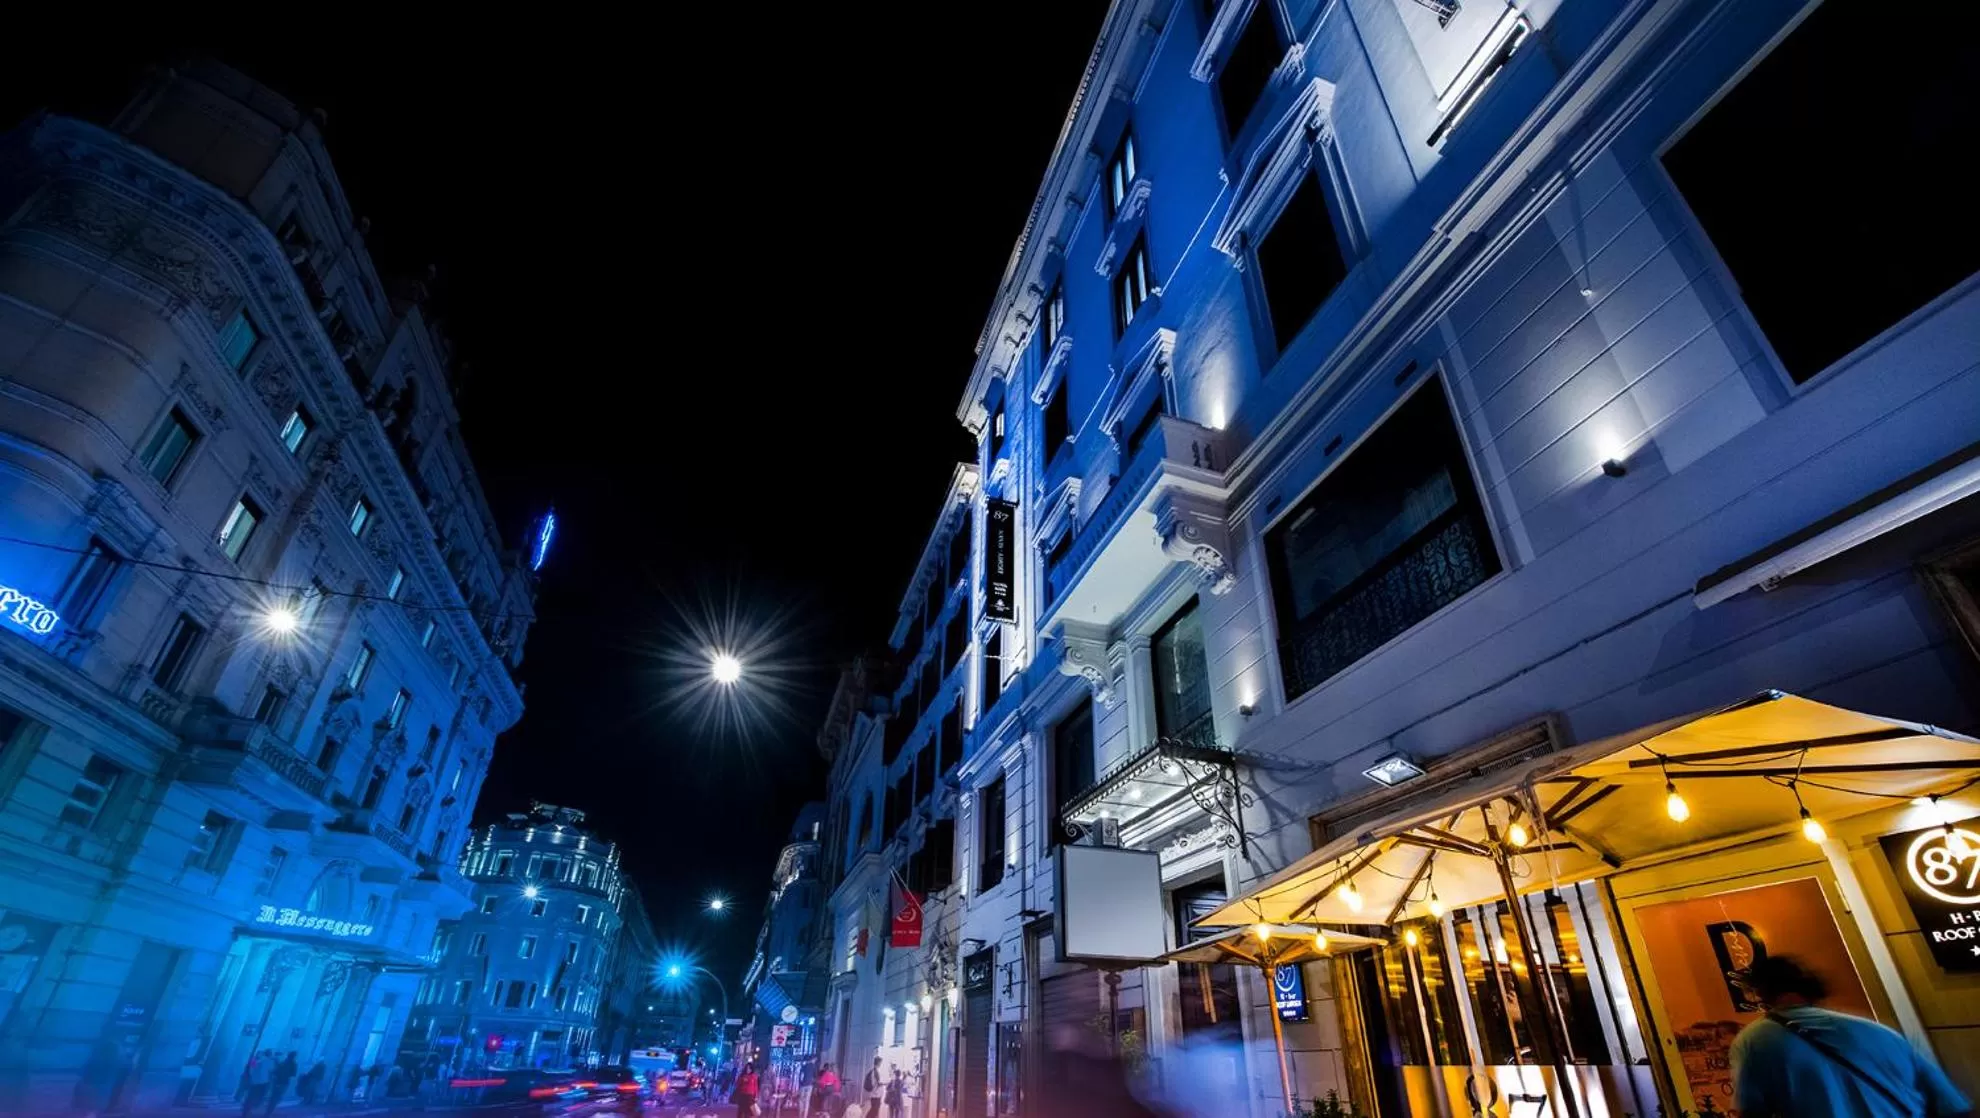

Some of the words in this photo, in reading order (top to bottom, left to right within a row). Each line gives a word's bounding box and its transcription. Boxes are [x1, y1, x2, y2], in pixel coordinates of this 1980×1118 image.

[993, 510, 1010, 523] 87
[275, 908, 374, 937] Messaggero
[1932, 926, 1976, 943] ROOF
